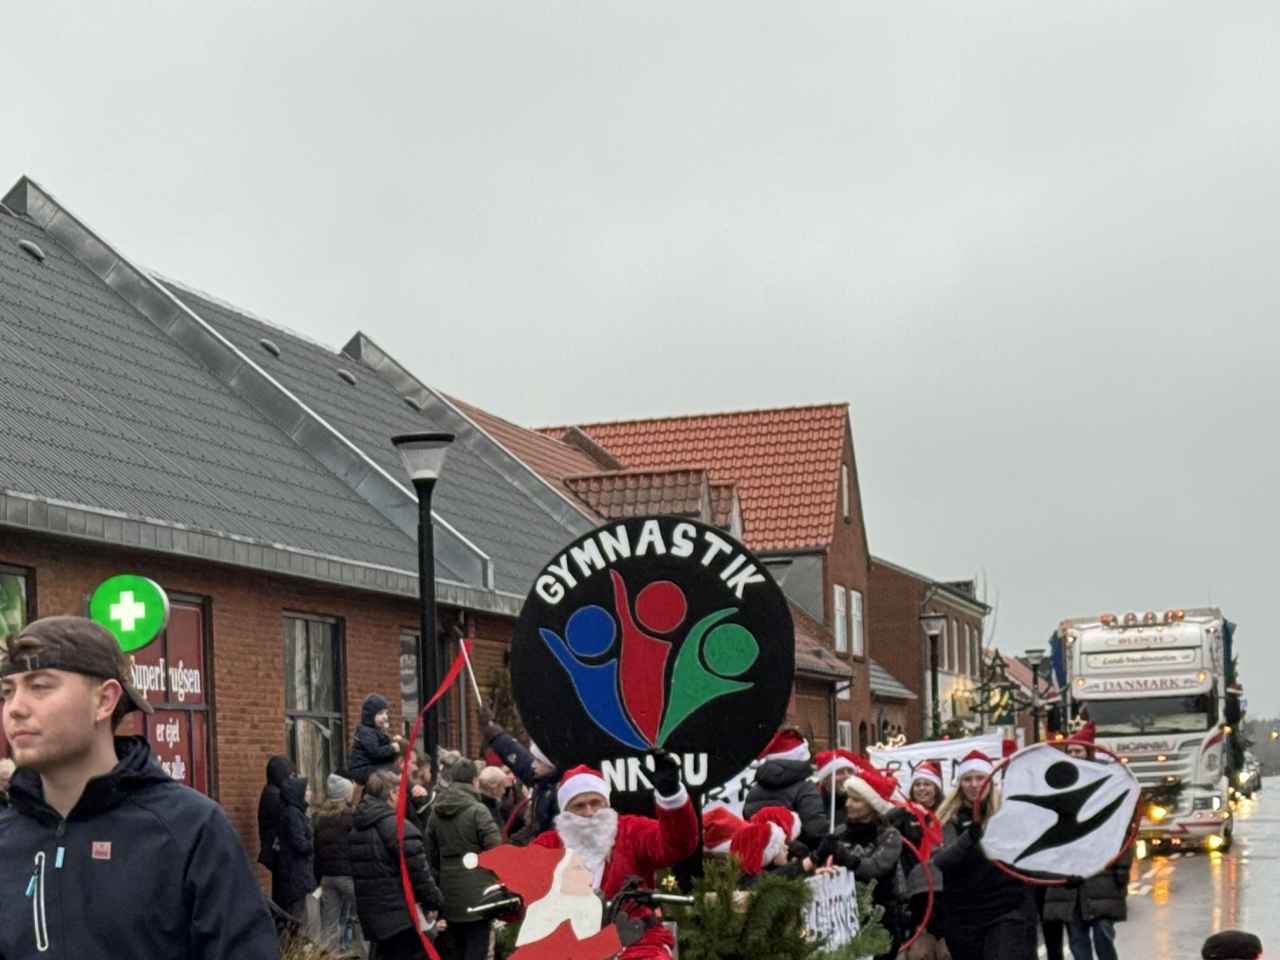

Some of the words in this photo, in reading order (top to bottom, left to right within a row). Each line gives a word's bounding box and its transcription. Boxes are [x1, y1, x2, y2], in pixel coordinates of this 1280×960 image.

[535, 519, 766, 605] GYMNASTIK
[1103, 677, 1180, 691] DANMARK
[601, 753, 708, 792] NNU
